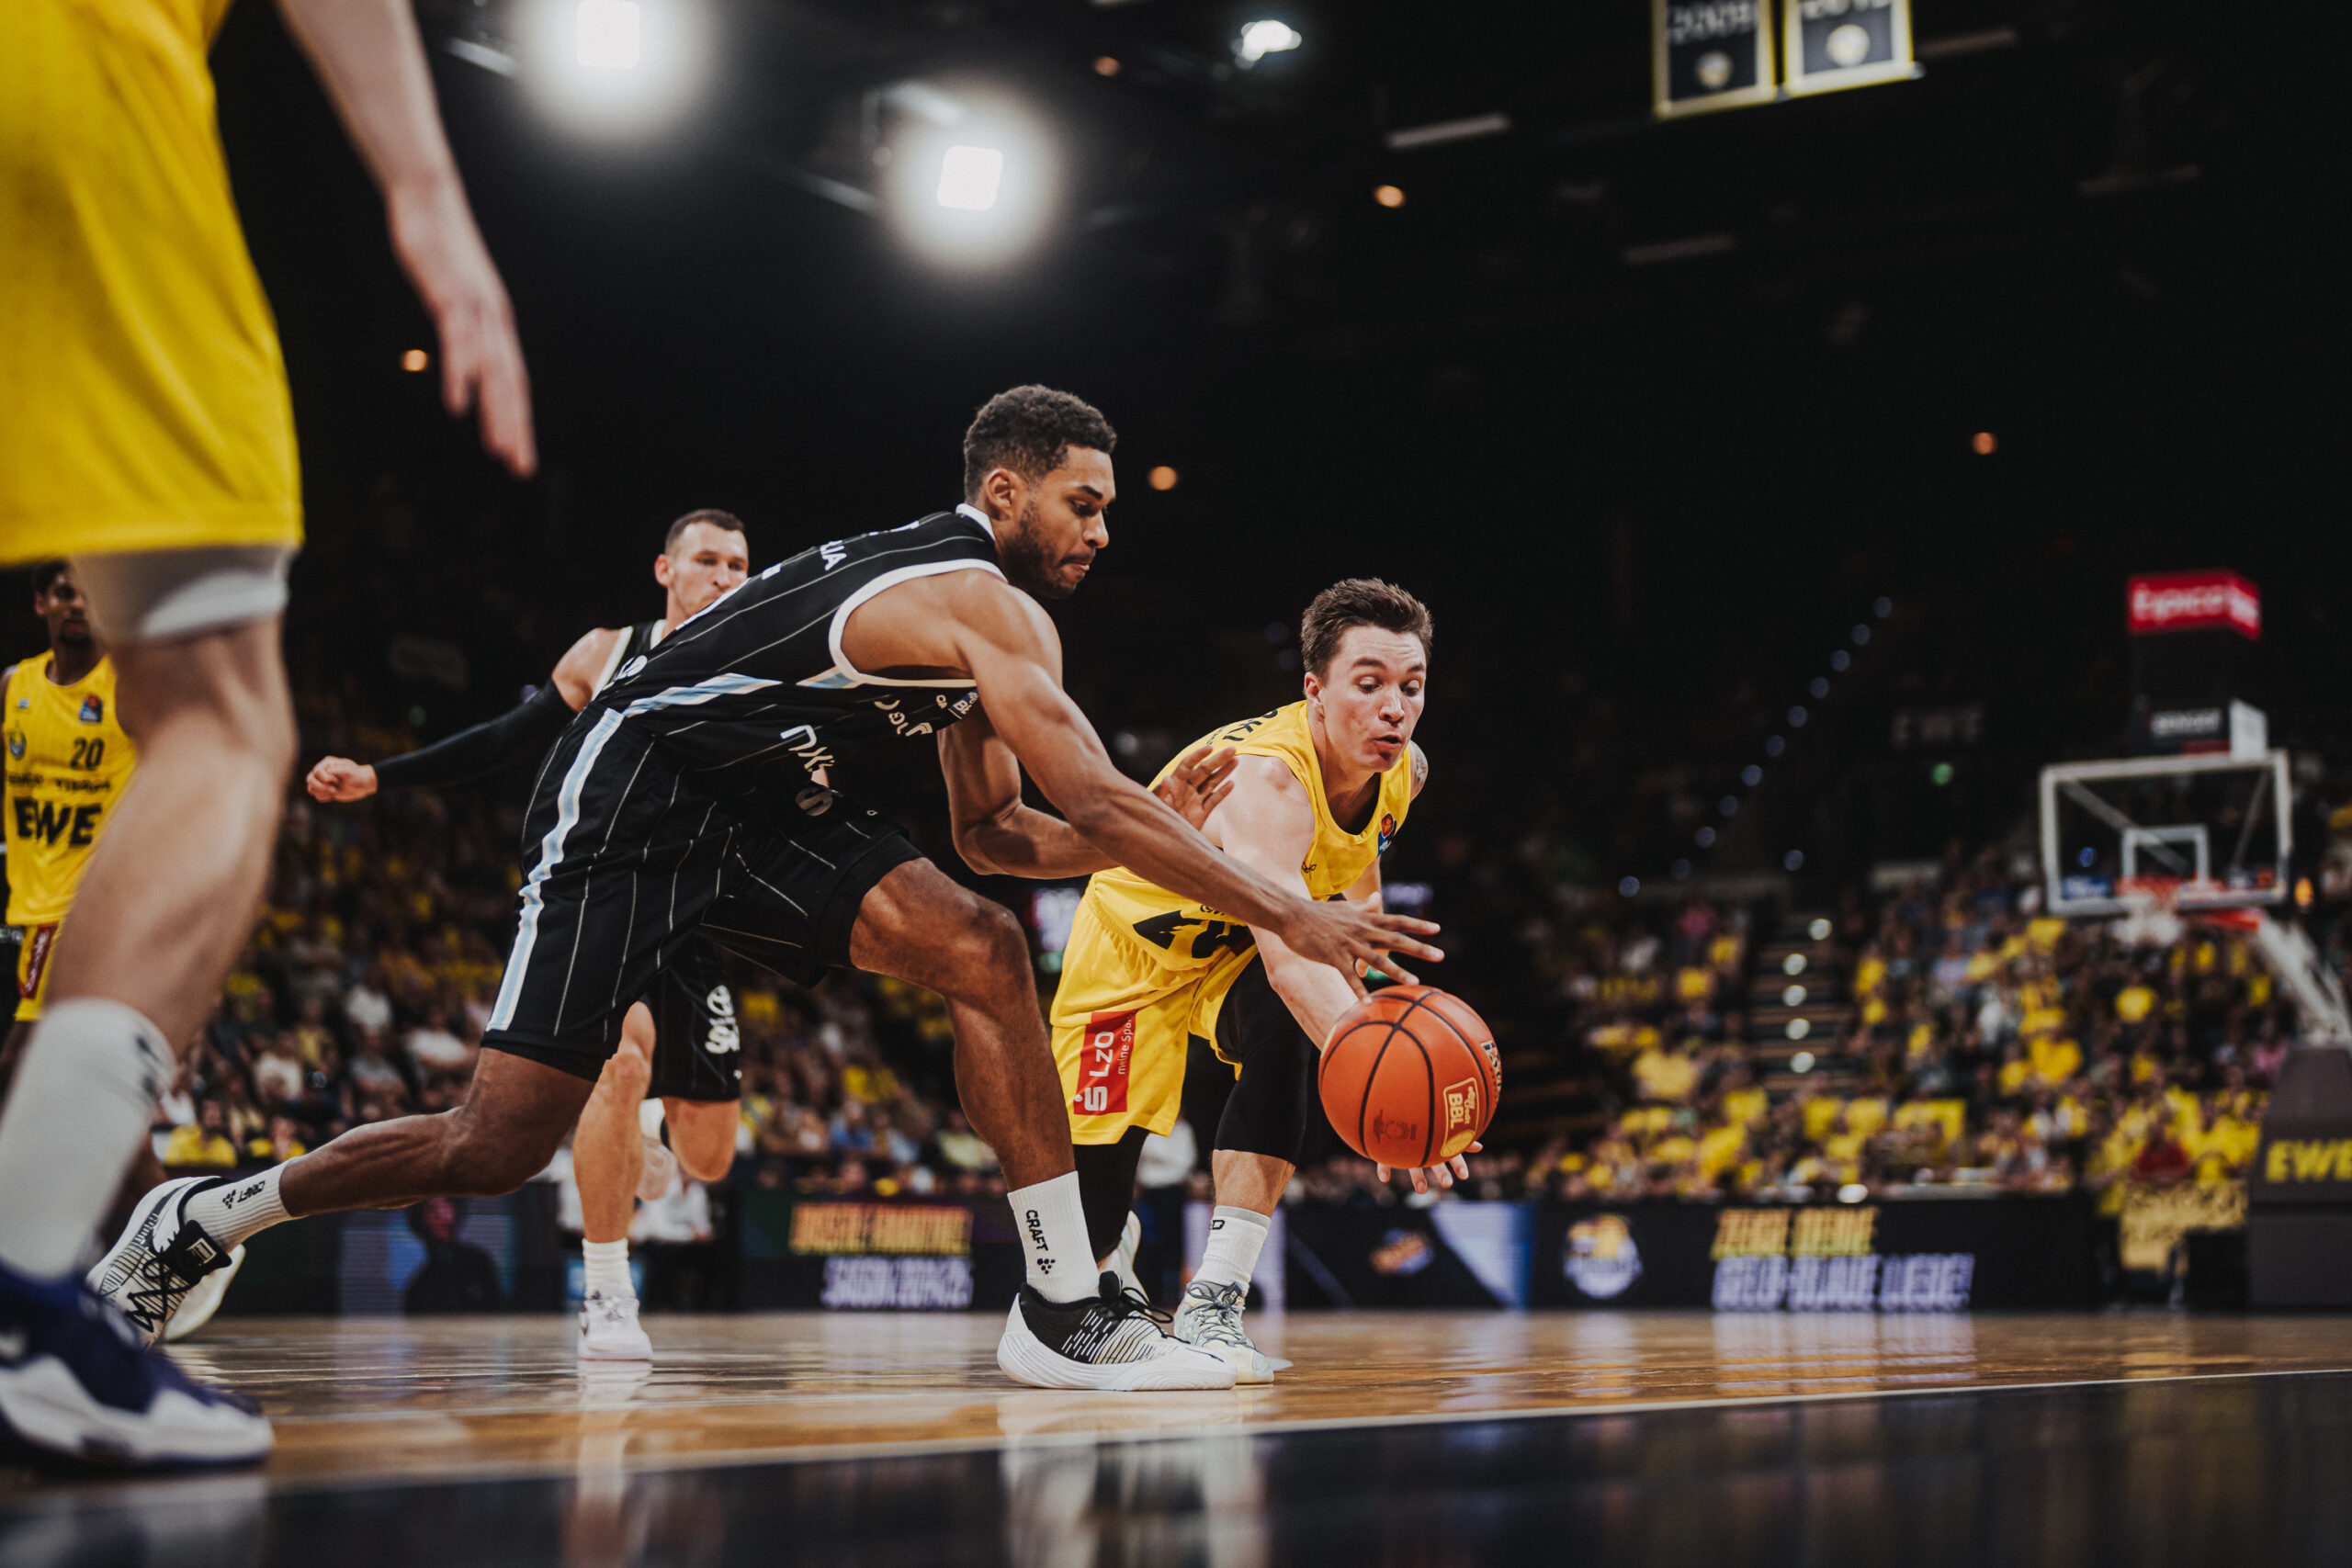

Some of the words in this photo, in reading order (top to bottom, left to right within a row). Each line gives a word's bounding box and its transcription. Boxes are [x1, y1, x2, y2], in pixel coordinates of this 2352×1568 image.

[70, 737, 105, 770] 20
[14, 796, 102, 847] EWE
[1089, 1031, 1114, 1077] LZO
[1449, 1093, 1464, 1129] BBL
[2266, 1140, 2352, 1182] EWE
[1025, 1210, 1049, 1251] CRAFT
